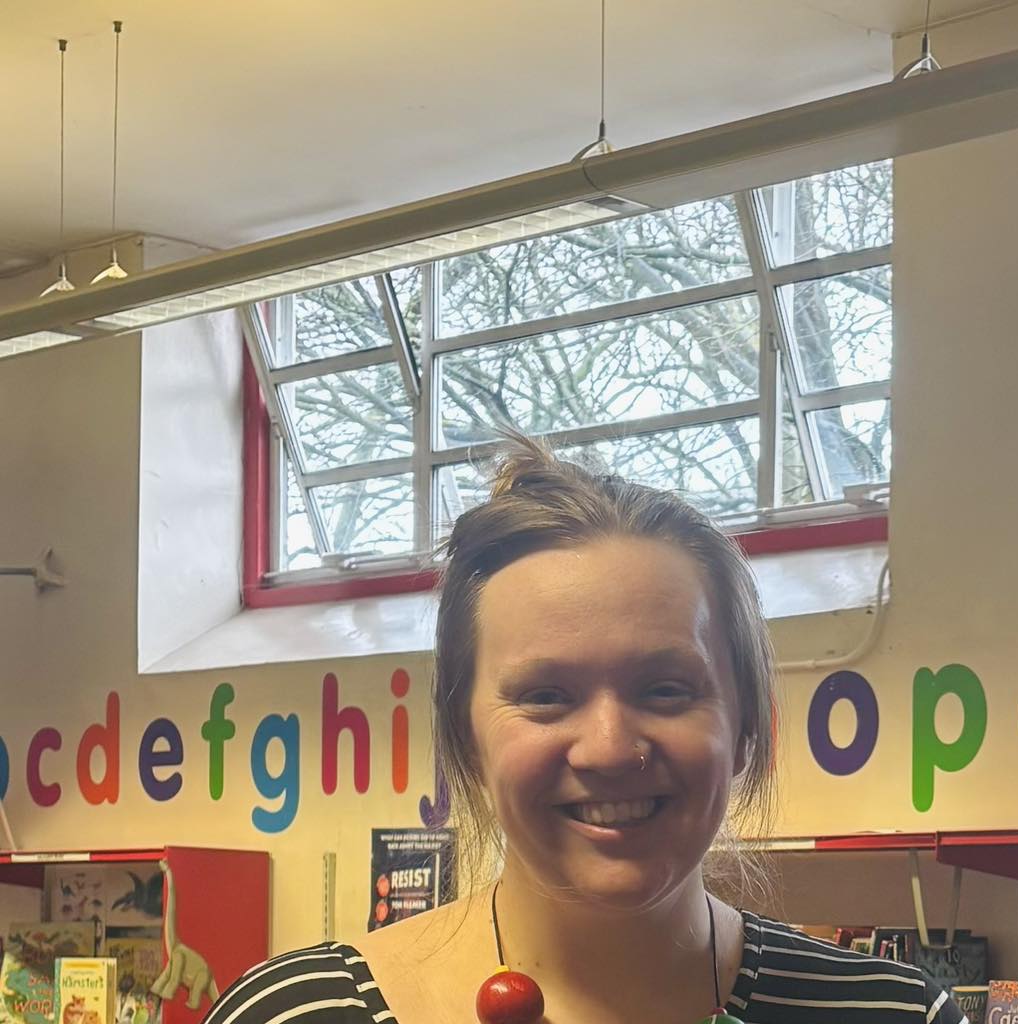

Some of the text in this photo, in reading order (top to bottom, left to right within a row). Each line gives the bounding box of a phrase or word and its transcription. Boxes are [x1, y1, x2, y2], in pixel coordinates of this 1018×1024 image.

[27, 727, 62, 807] c
[76, 691, 120, 804] d
[139, 718, 183, 801] e
[201, 682, 236, 801] f
[251, 713, 300, 833] g
[322, 672, 370, 795] h
[390, 667, 411, 794] i
[807, 670, 880, 777] o
[911, 663, 988, 813] p
[391, 867, 432, 889] RESIST
